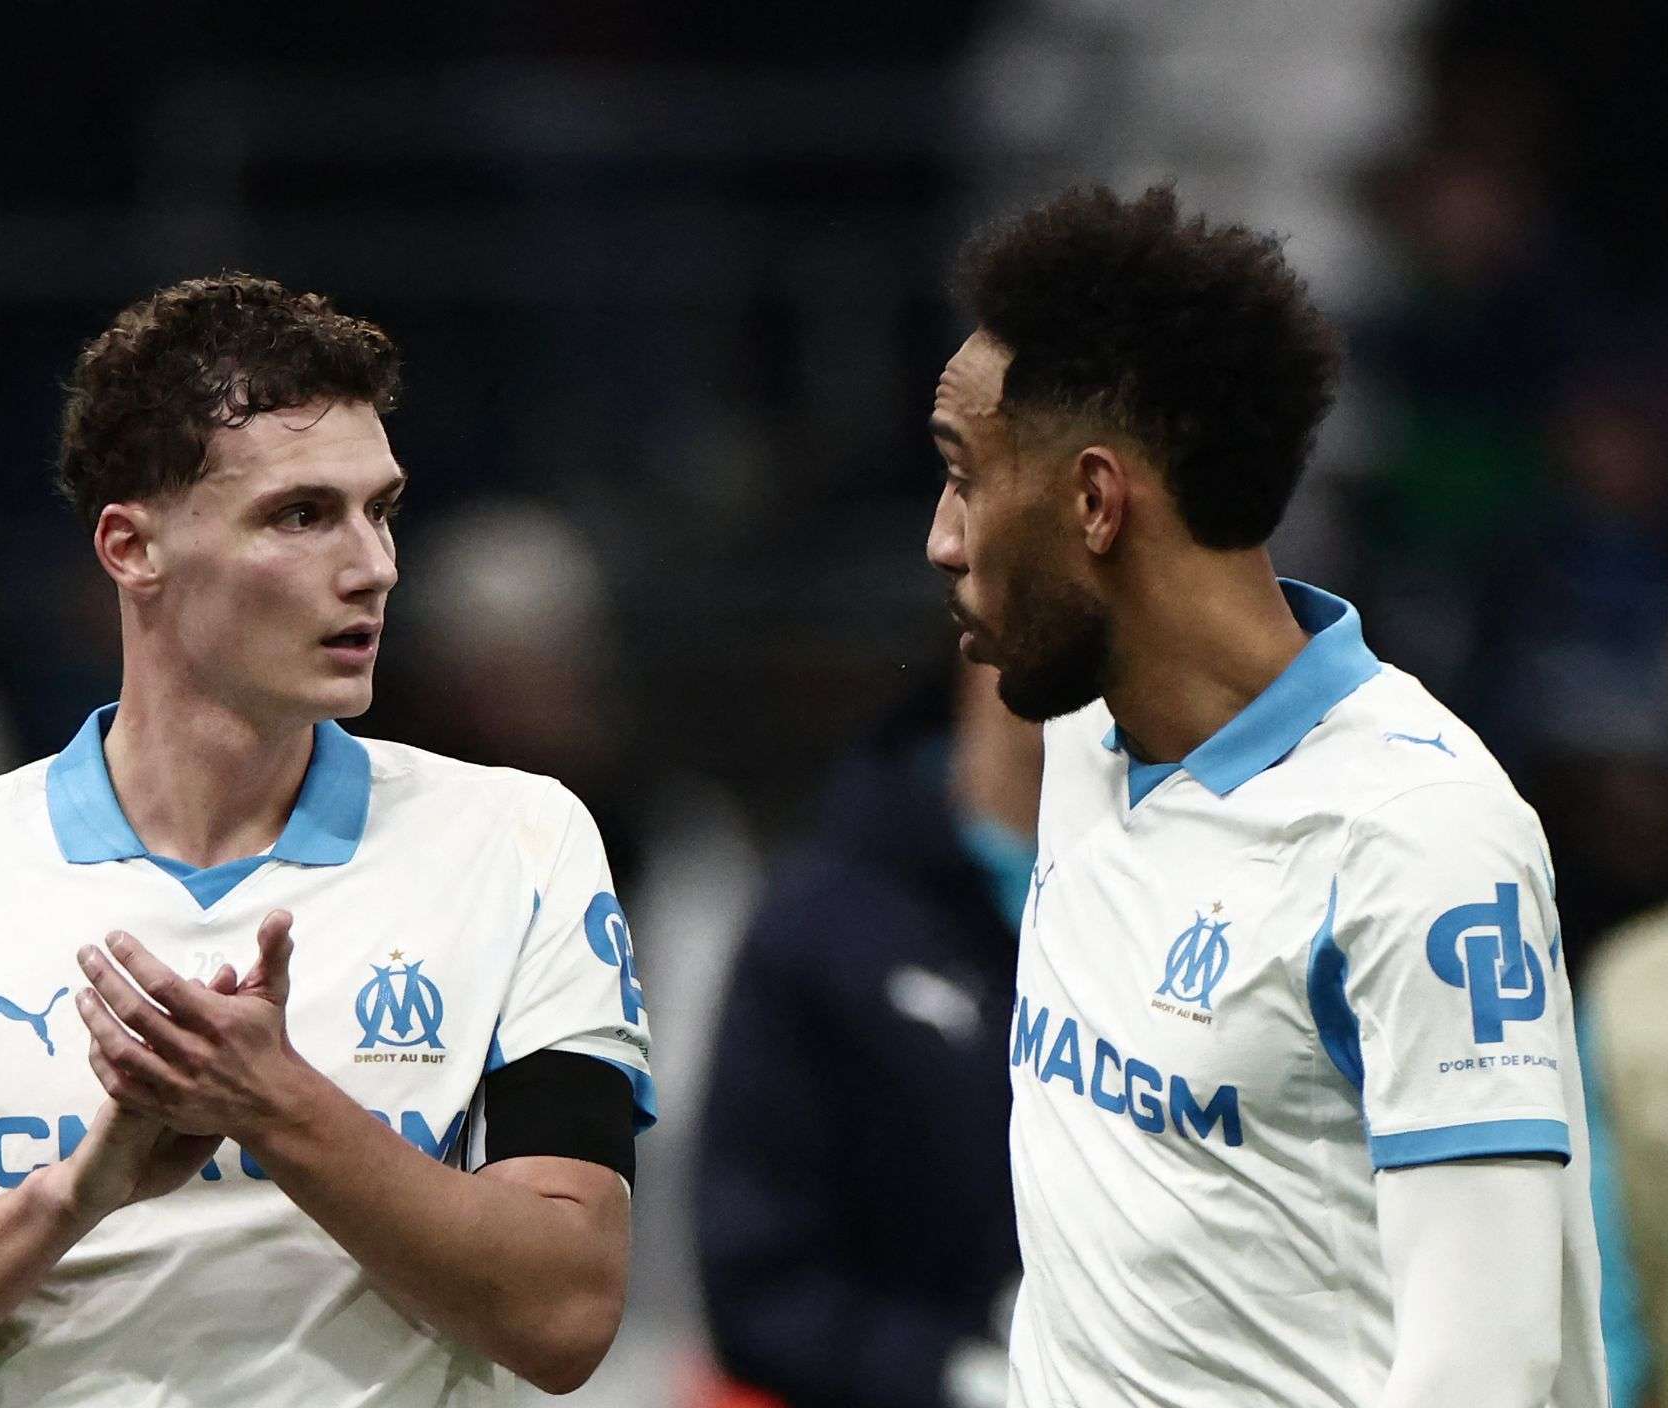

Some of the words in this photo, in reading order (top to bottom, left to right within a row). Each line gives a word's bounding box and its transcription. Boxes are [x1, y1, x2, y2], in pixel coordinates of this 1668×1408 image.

[354, 1053, 397, 1063] DROIT
[400, 1053, 418, 1063] AU
[421, 1053, 446, 1064] BUT
[1479, 1056, 1497, 1068] ET
[1501, 1055, 1519, 1066] DE
